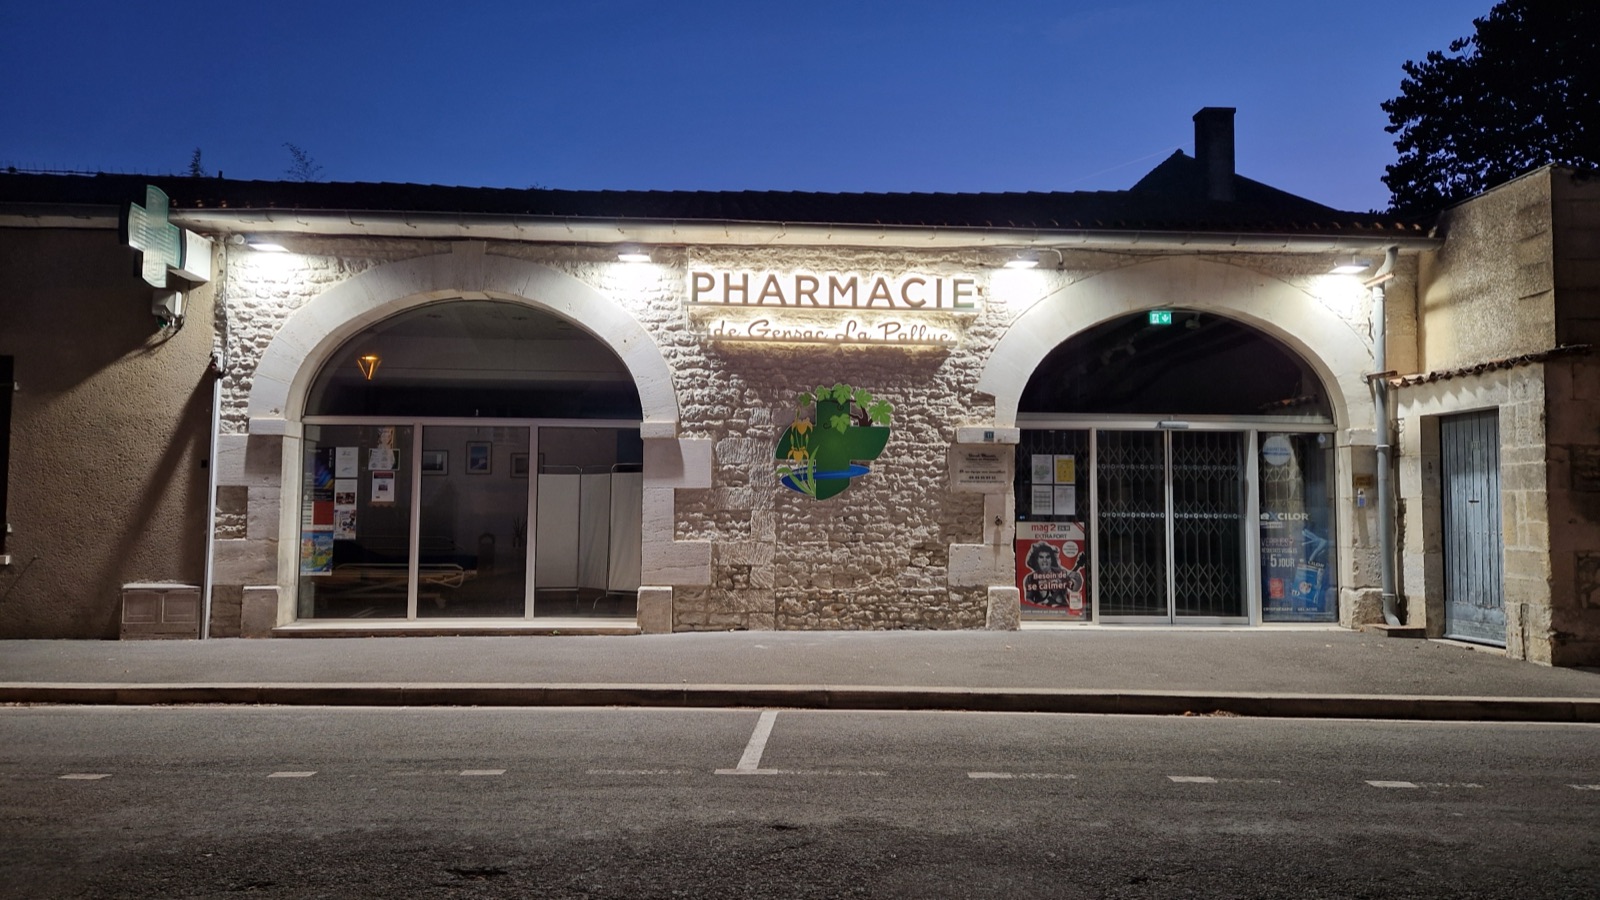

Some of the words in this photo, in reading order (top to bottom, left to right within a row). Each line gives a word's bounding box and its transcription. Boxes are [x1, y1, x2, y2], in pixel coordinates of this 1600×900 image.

[691, 271, 975, 308] PHARMACIE
[713, 319, 741, 338] de
[747, 319, 828, 340] Gensac
[834, 319, 872, 342] La
[877, 321, 954, 343] Pallue
[1031, 524, 1049, 533] mag
[1050, 523, 1056, 532] 2
[1033, 572, 1057, 580] Besoin
[1058, 571, 1067, 579] de
[1027, 583, 1037, 591] se
[1038, 581, 1067, 590] calmer
